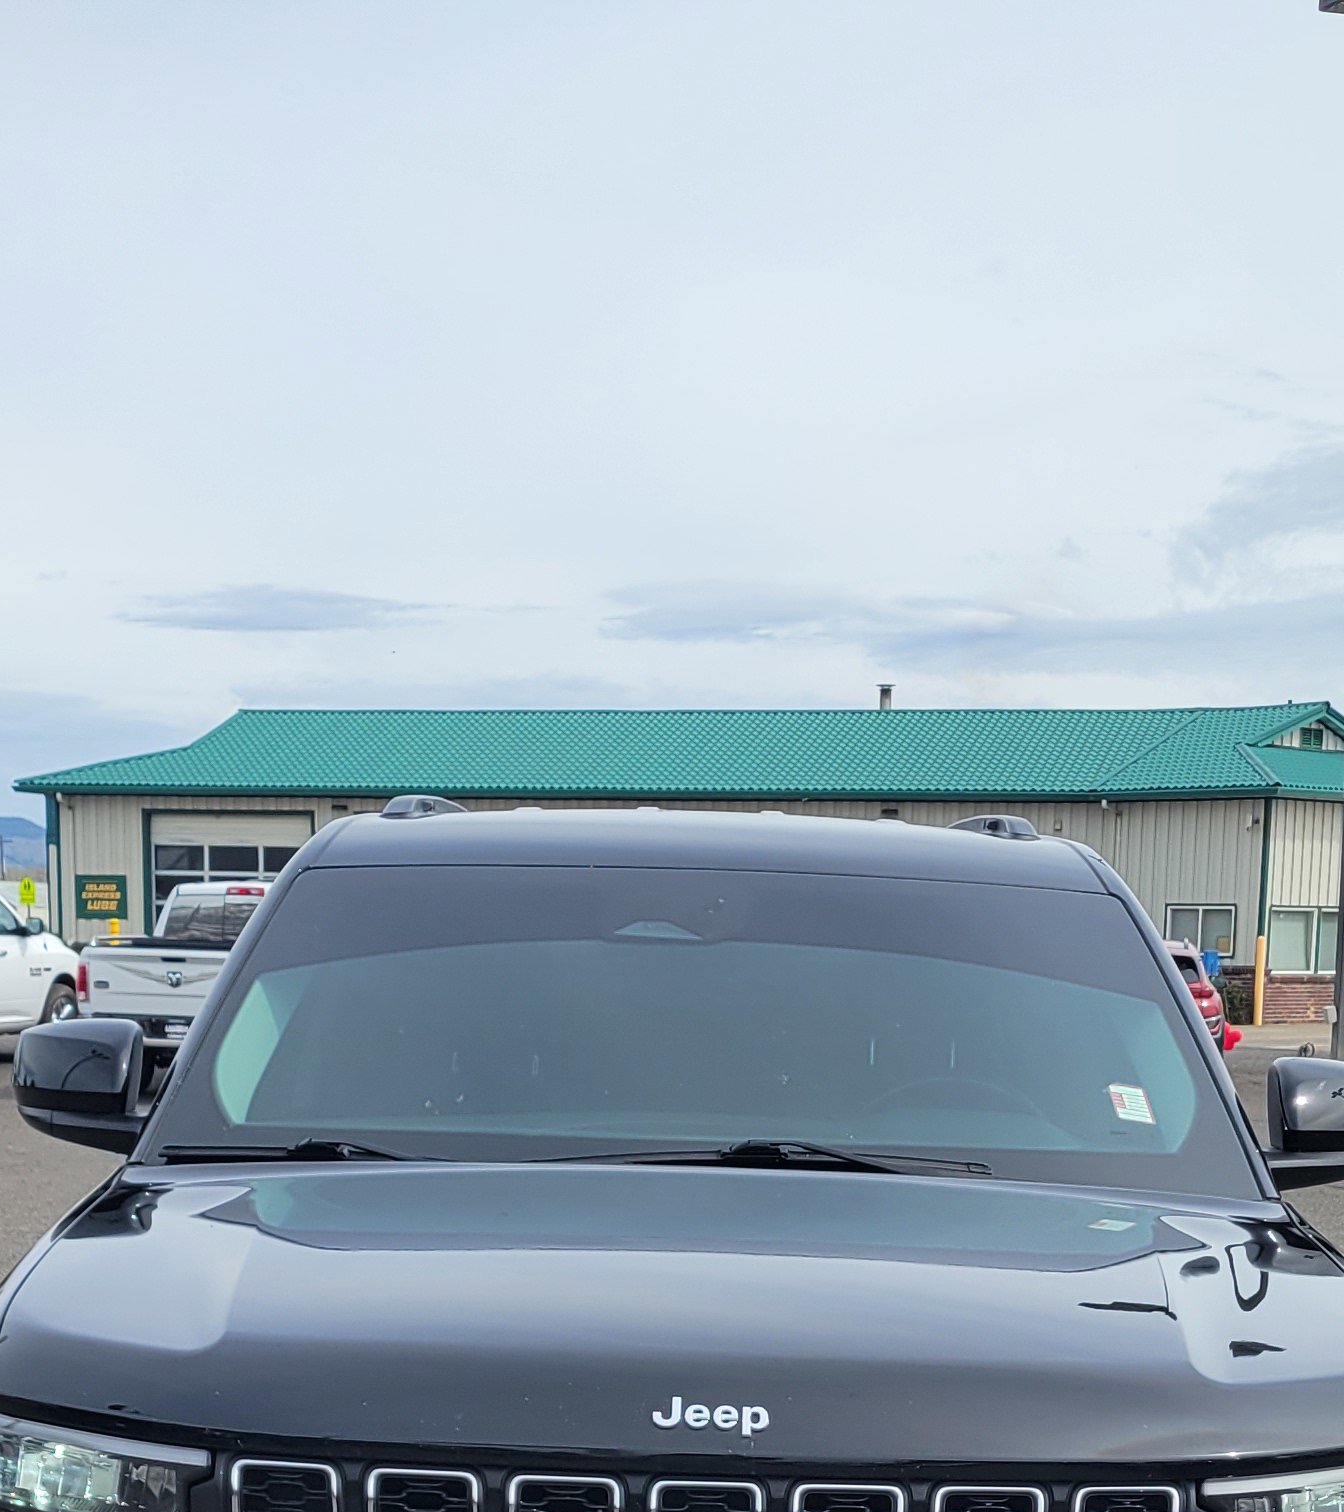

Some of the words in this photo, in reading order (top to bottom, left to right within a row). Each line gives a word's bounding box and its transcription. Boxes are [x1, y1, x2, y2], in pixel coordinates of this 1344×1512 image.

[85, 883, 117, 891] ISLAND
[81, 891, 121, 899] EXPRESS
[87, 900, 118, 911] LUBE
[652, 1396, 769, 1437] Jeep
